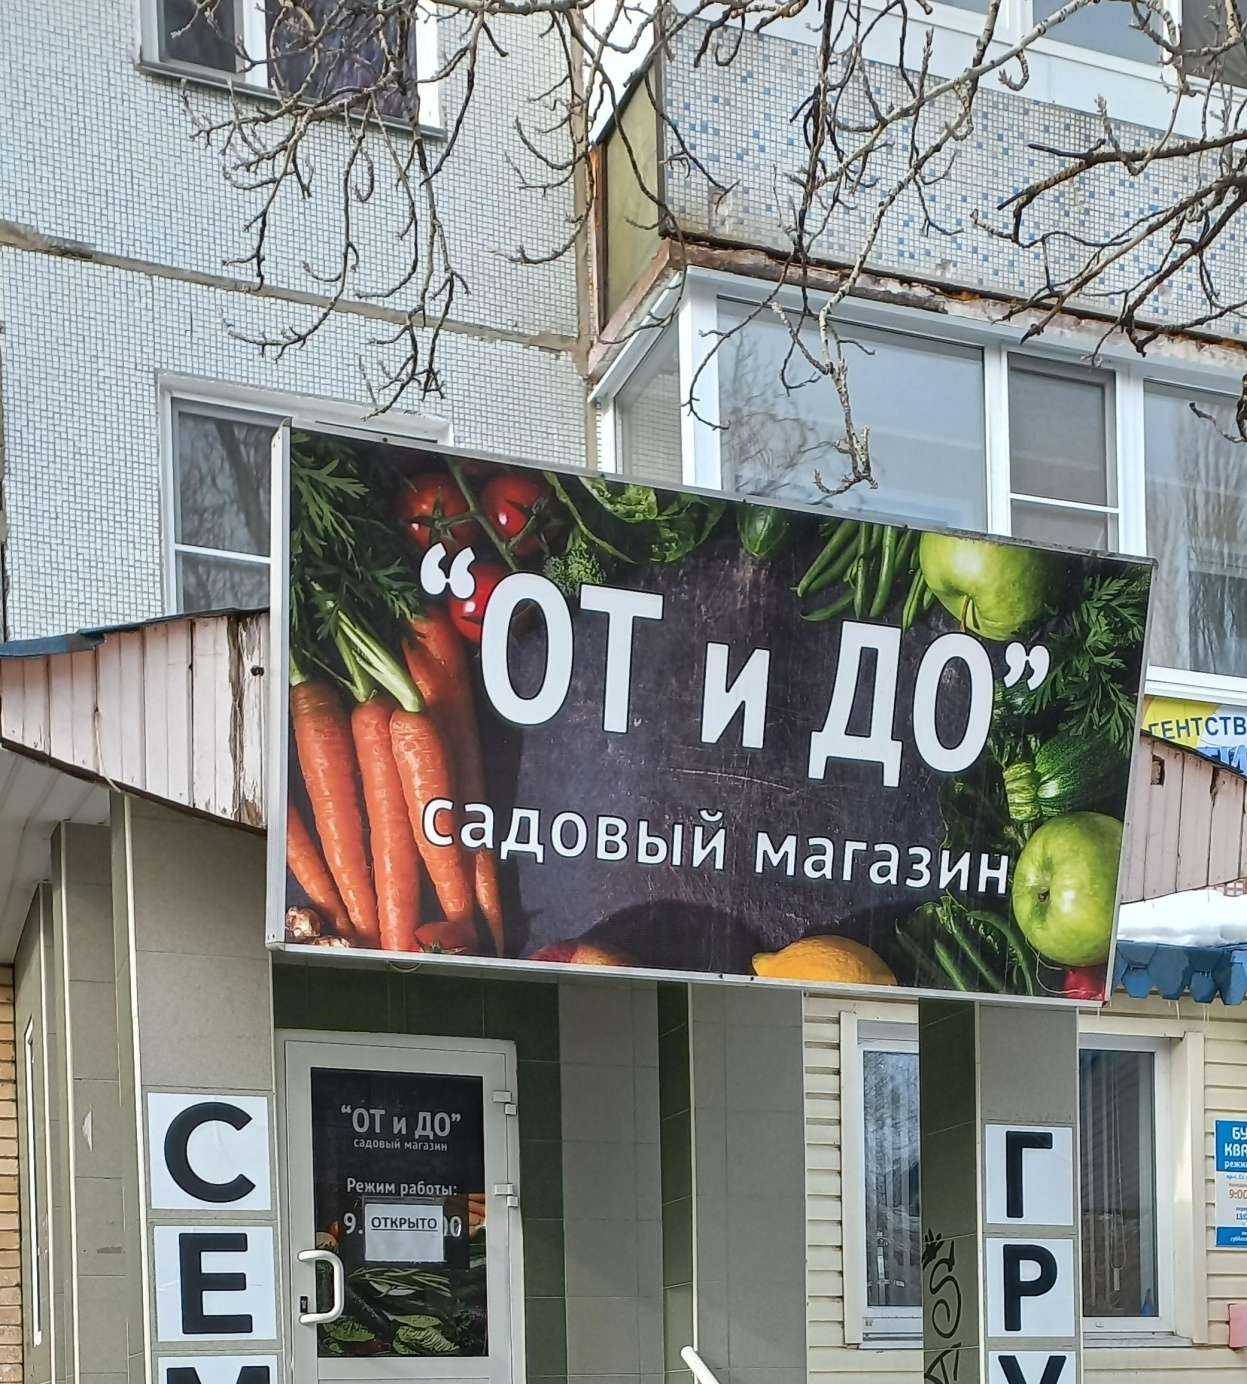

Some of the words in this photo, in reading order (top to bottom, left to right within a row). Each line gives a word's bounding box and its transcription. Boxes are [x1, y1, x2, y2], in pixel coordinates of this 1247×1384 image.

[420, 541, 664, 735] “ОТ
[700, 641, 771, 750] и
[808, 620, 1050, 788] ДО”
[421, 797, 725, 871] садовый
[754, 831, 1009, 895] магазин
[392, 1116, 407, 1135] и
[353, 1138, 401, 1149] садовый
[404, 1141, 448, 1152] магазин
[346, 1177, 396, 1194] Режим
[400, 1180, 458, 1198] работы:
[370, 1216, 438, 1230] ОТКРЫТО
